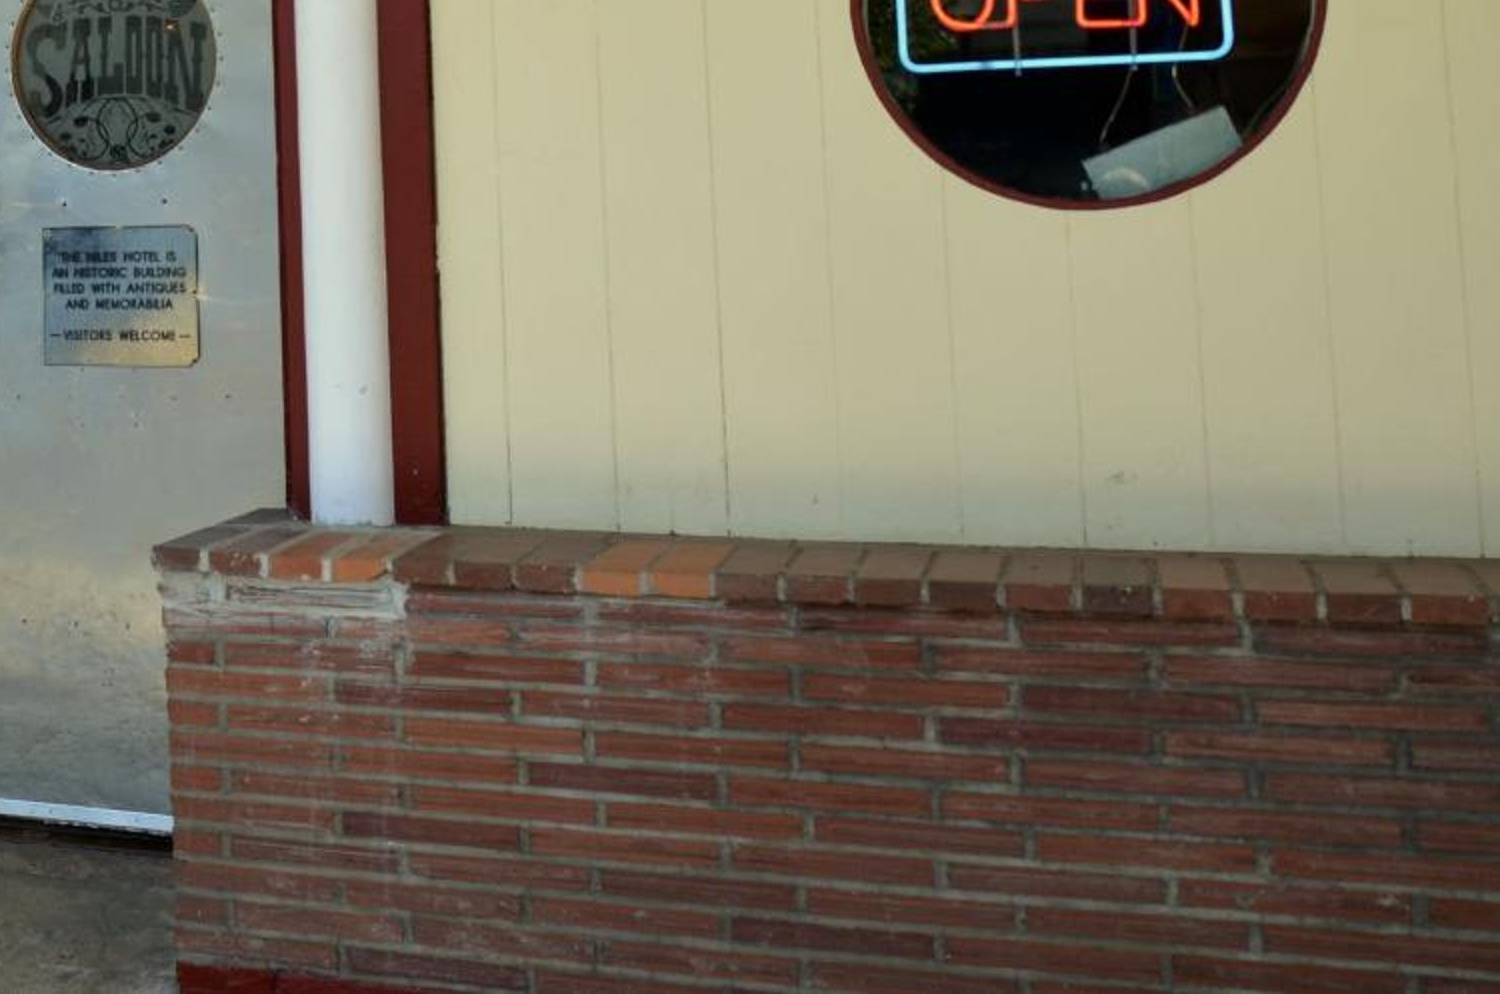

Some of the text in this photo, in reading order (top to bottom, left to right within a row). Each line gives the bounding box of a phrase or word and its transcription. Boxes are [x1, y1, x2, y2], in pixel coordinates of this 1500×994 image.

[26, 16, 207, 117] SALOON
[59, 251, 80, 263] THE
[123, 251, 160, 263] HOTEL
[165, 250, 177, 262] IS
[52, 267, 187, 278] AN HISTORIC BUILDING
[54, 282, 186, 294] FILLED WITH ANTIQUES
[65, 298, 173, 310] AND MEMORABILIA
[64, 329, 176, 341] VISITORS WELCOME
